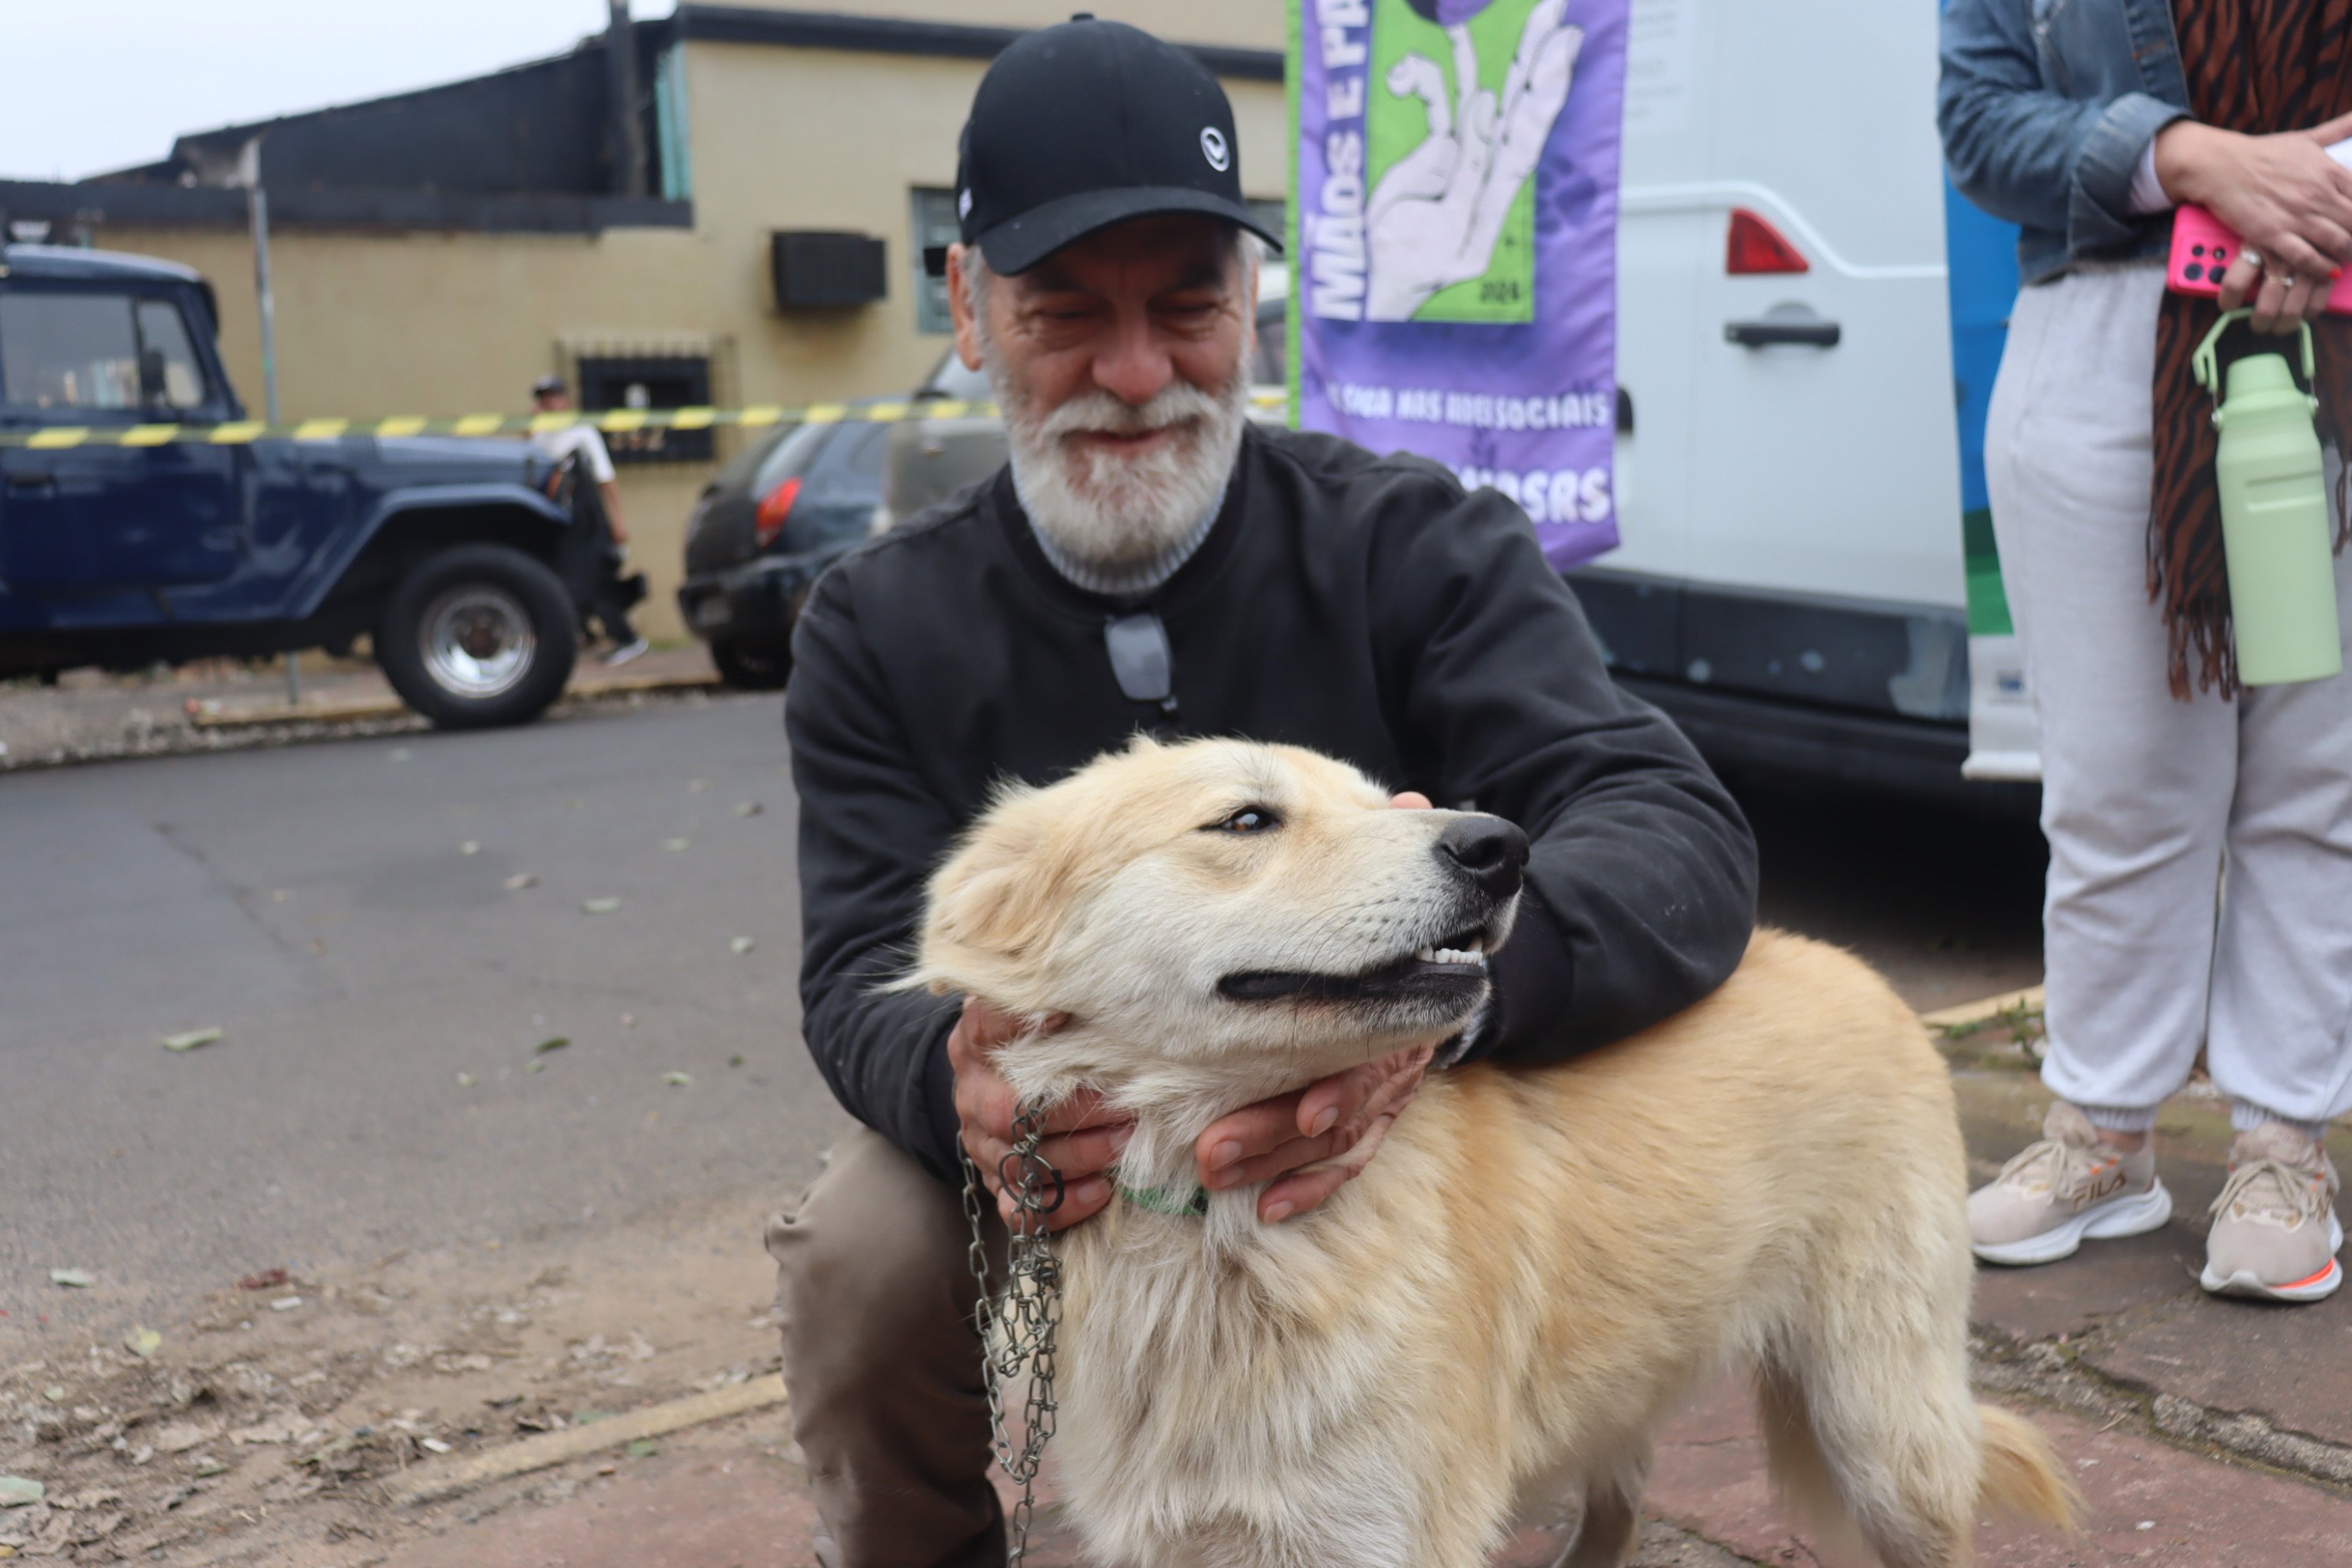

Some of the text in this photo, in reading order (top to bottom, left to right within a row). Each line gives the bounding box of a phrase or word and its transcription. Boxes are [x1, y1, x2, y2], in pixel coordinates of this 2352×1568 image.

[1326, 78, 1364, 120] E
[1303, 130, 1367, 321] MÃOS
[1397, 388, 1442, 424] NAS
[1495, 393, 1611, 430] SOCIAIS
[2074, 1169, 2127, 1212] FILA
